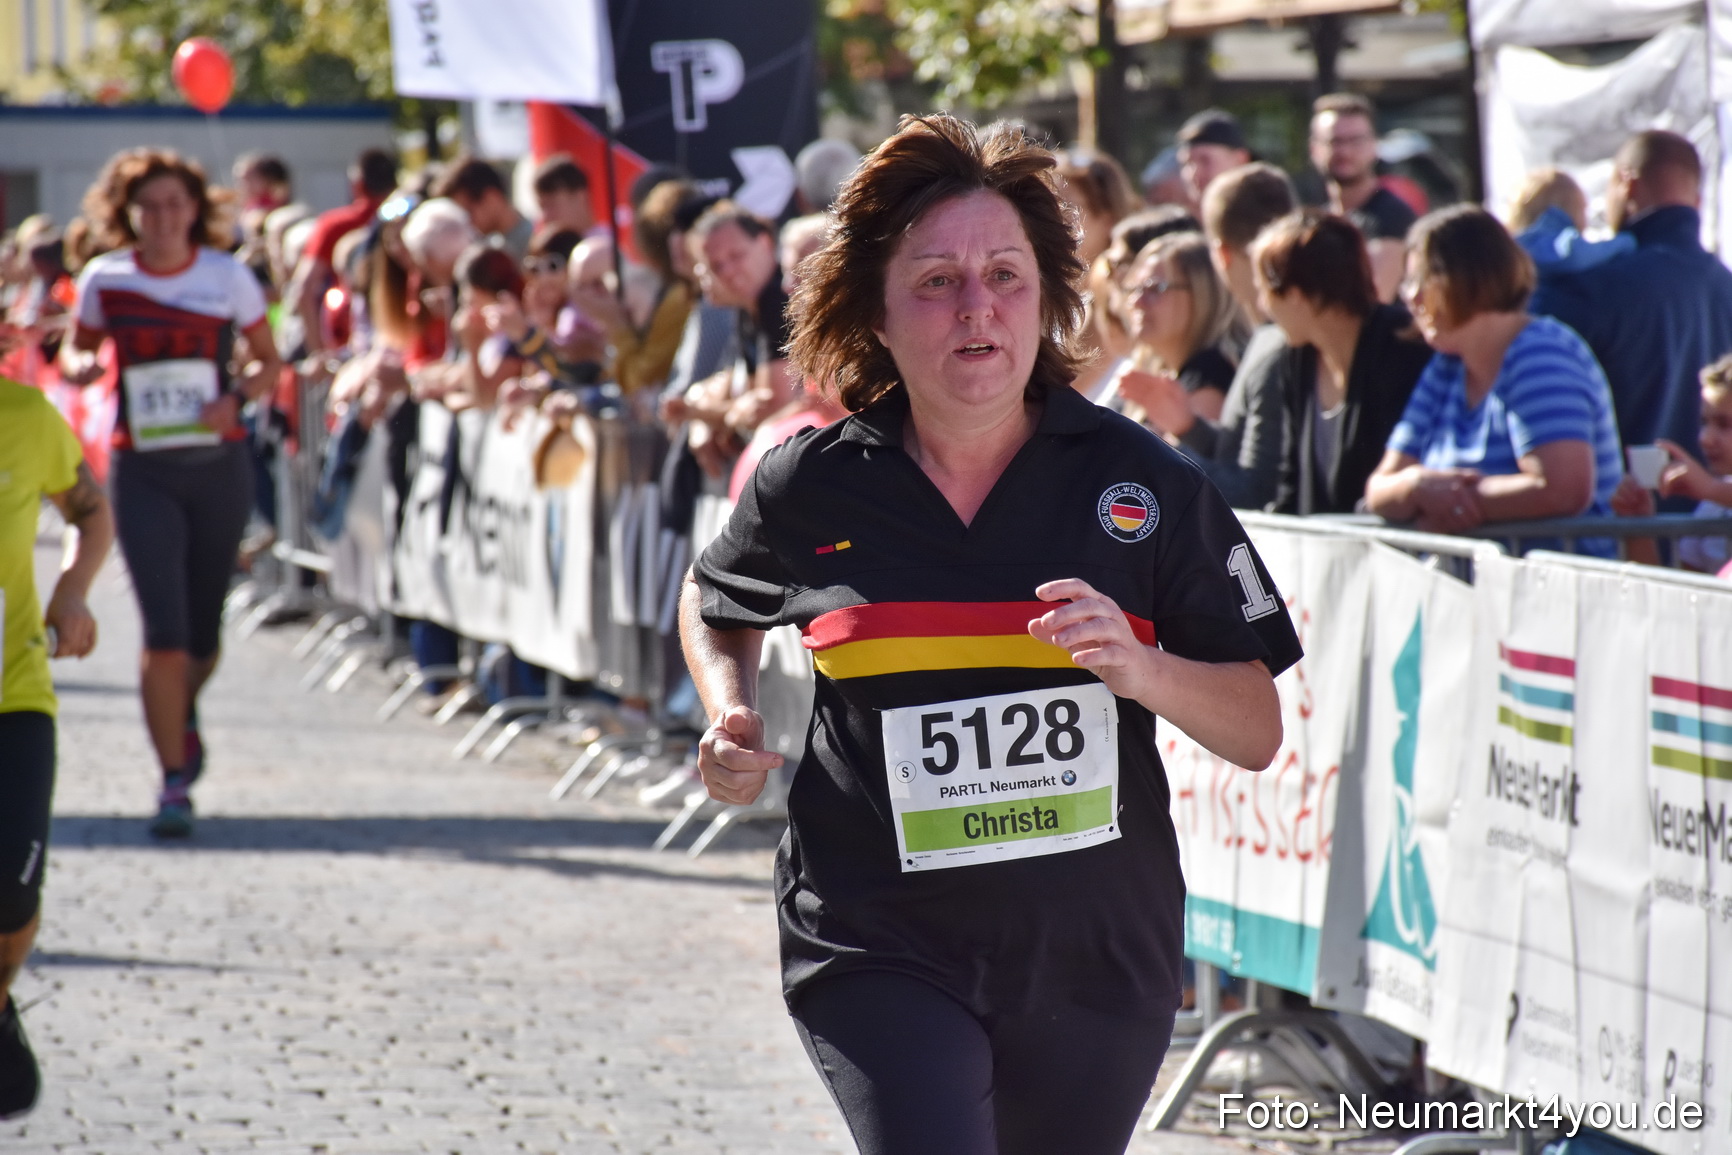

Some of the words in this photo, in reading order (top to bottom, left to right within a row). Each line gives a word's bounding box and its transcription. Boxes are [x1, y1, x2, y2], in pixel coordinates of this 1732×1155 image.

[1102, 515, 1115, 531] 2010
[921, 698, 1085, 776] 5128
[940, 782, 988, 799] PARTL
[990, 776, 1056, 793] Neumarkt
[963, 805, 1059, 840] Christa
